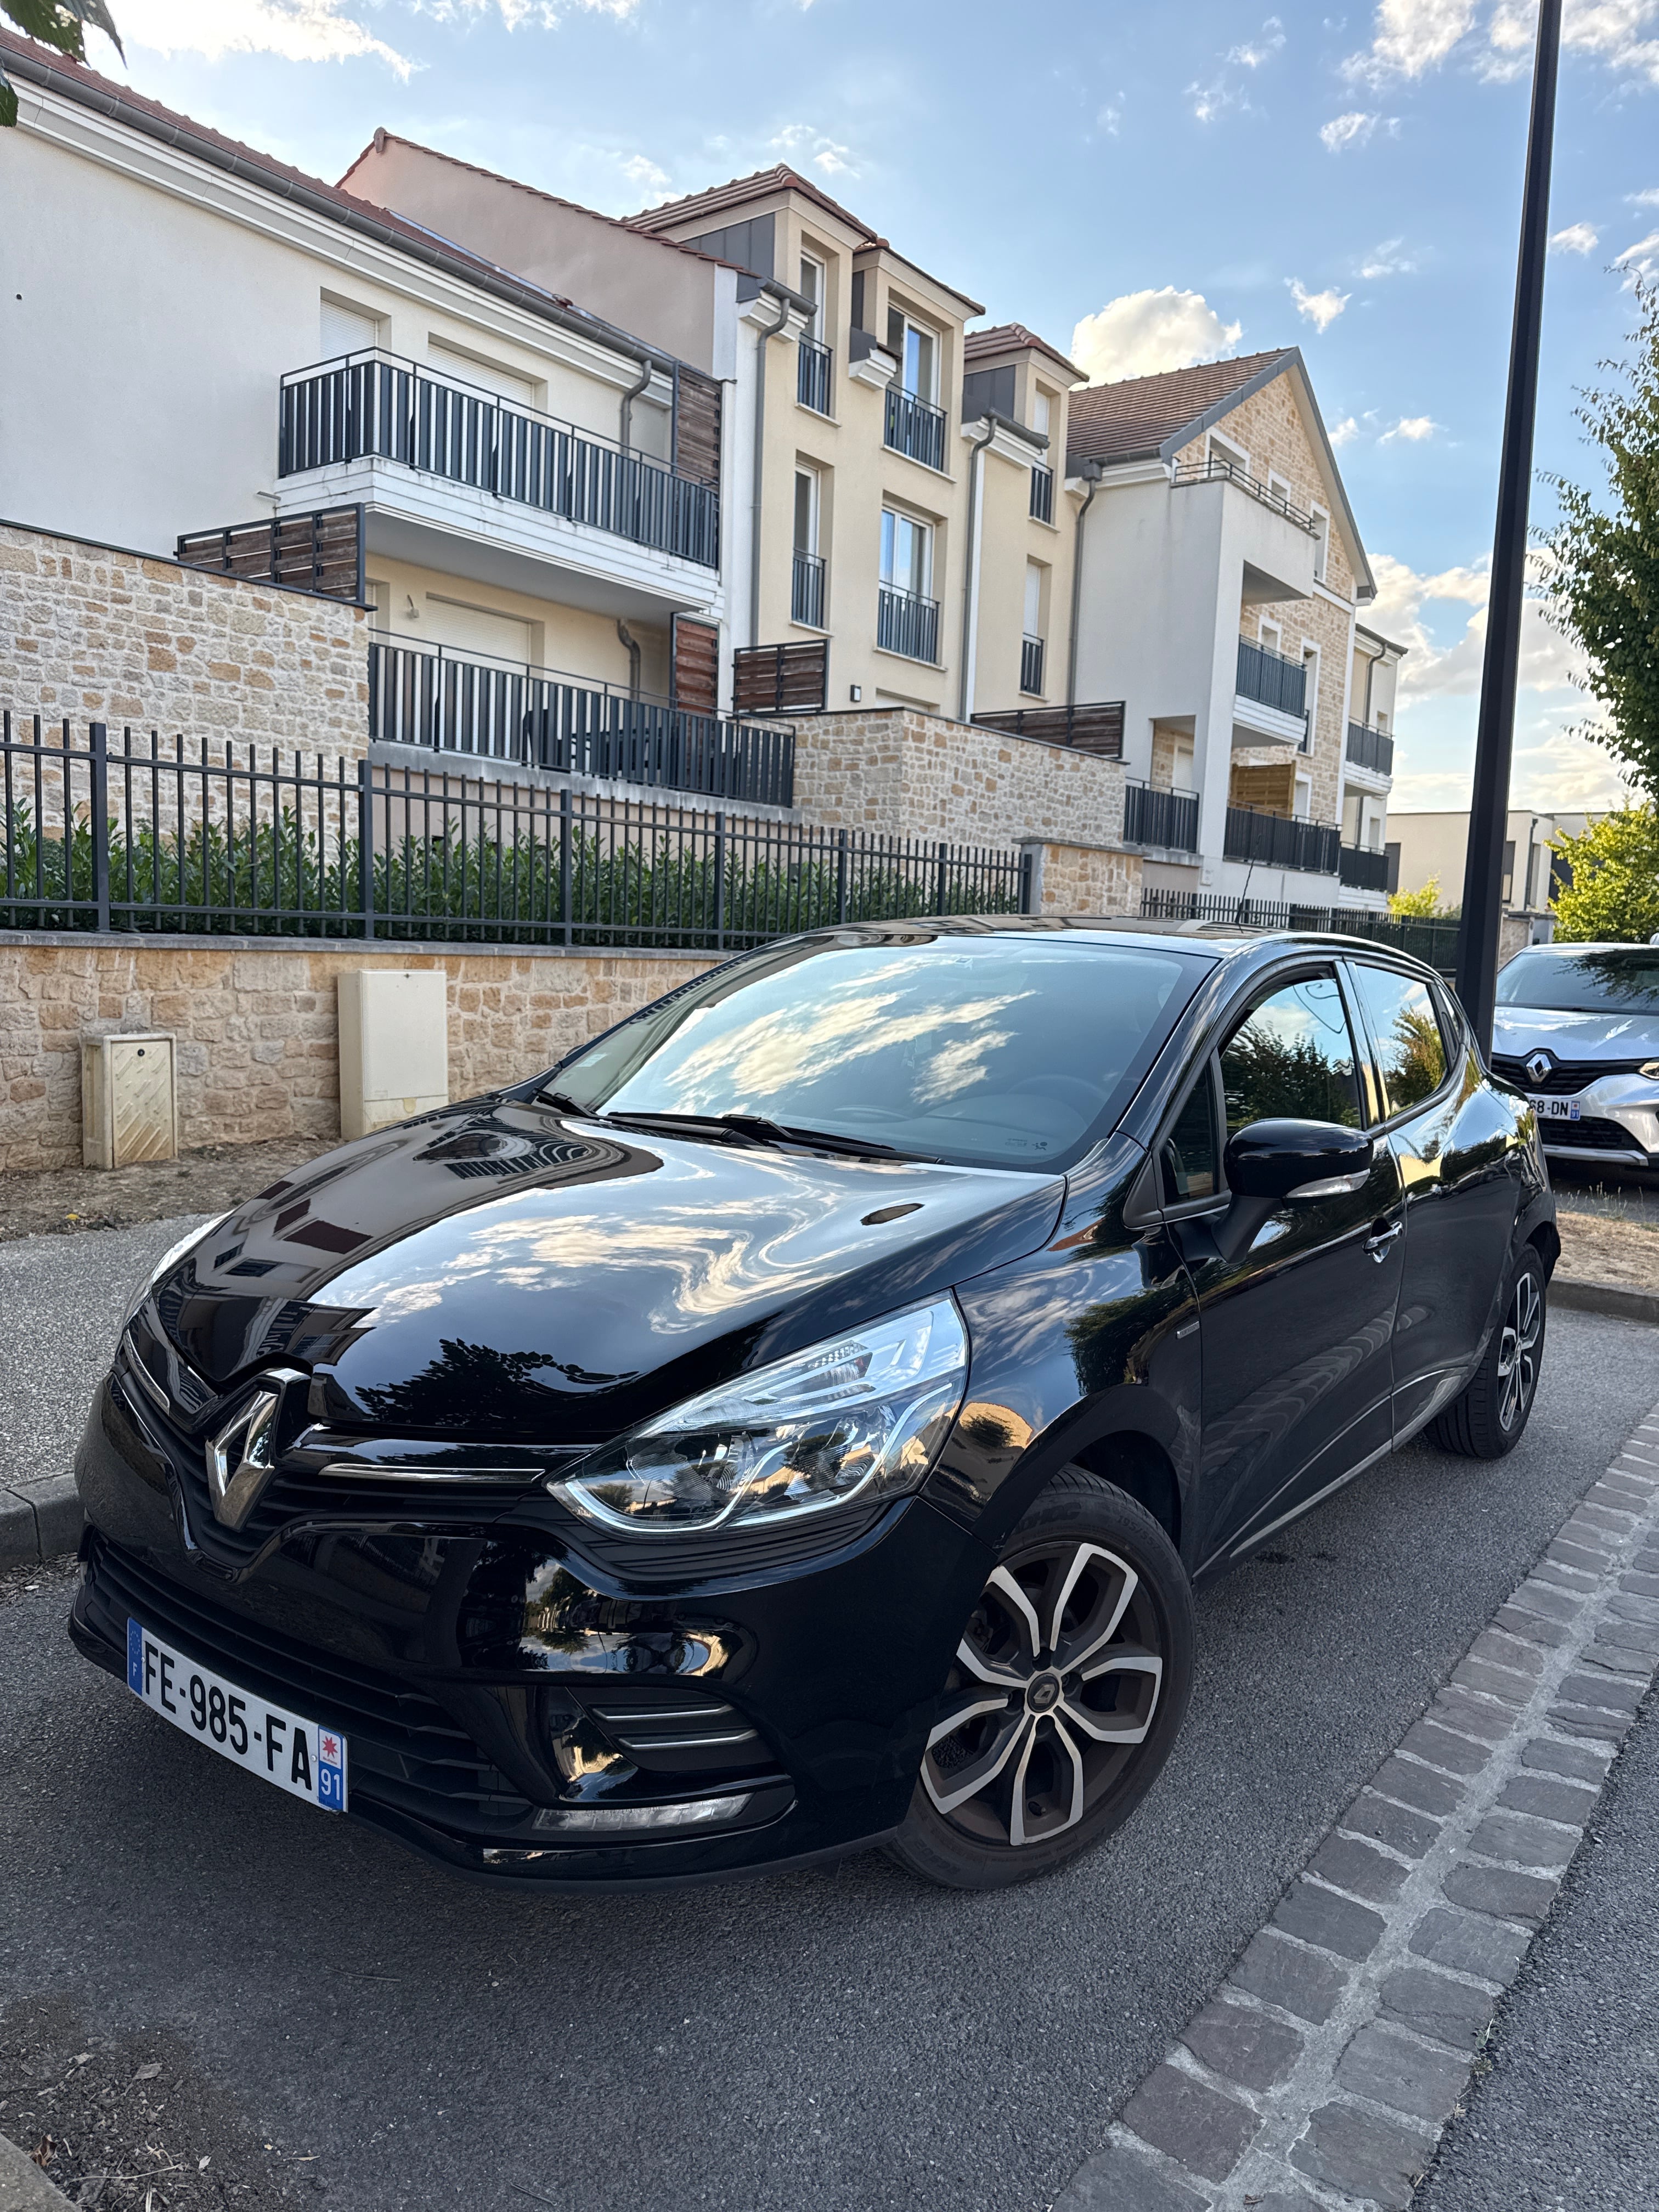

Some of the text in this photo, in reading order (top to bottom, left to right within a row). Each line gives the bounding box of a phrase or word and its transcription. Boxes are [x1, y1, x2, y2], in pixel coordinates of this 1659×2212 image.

[133, 1661, 138, 1677] F
[144, 1640, 312, 1791] FE-985-FA
[320, 1769, 340, 1801] 91
